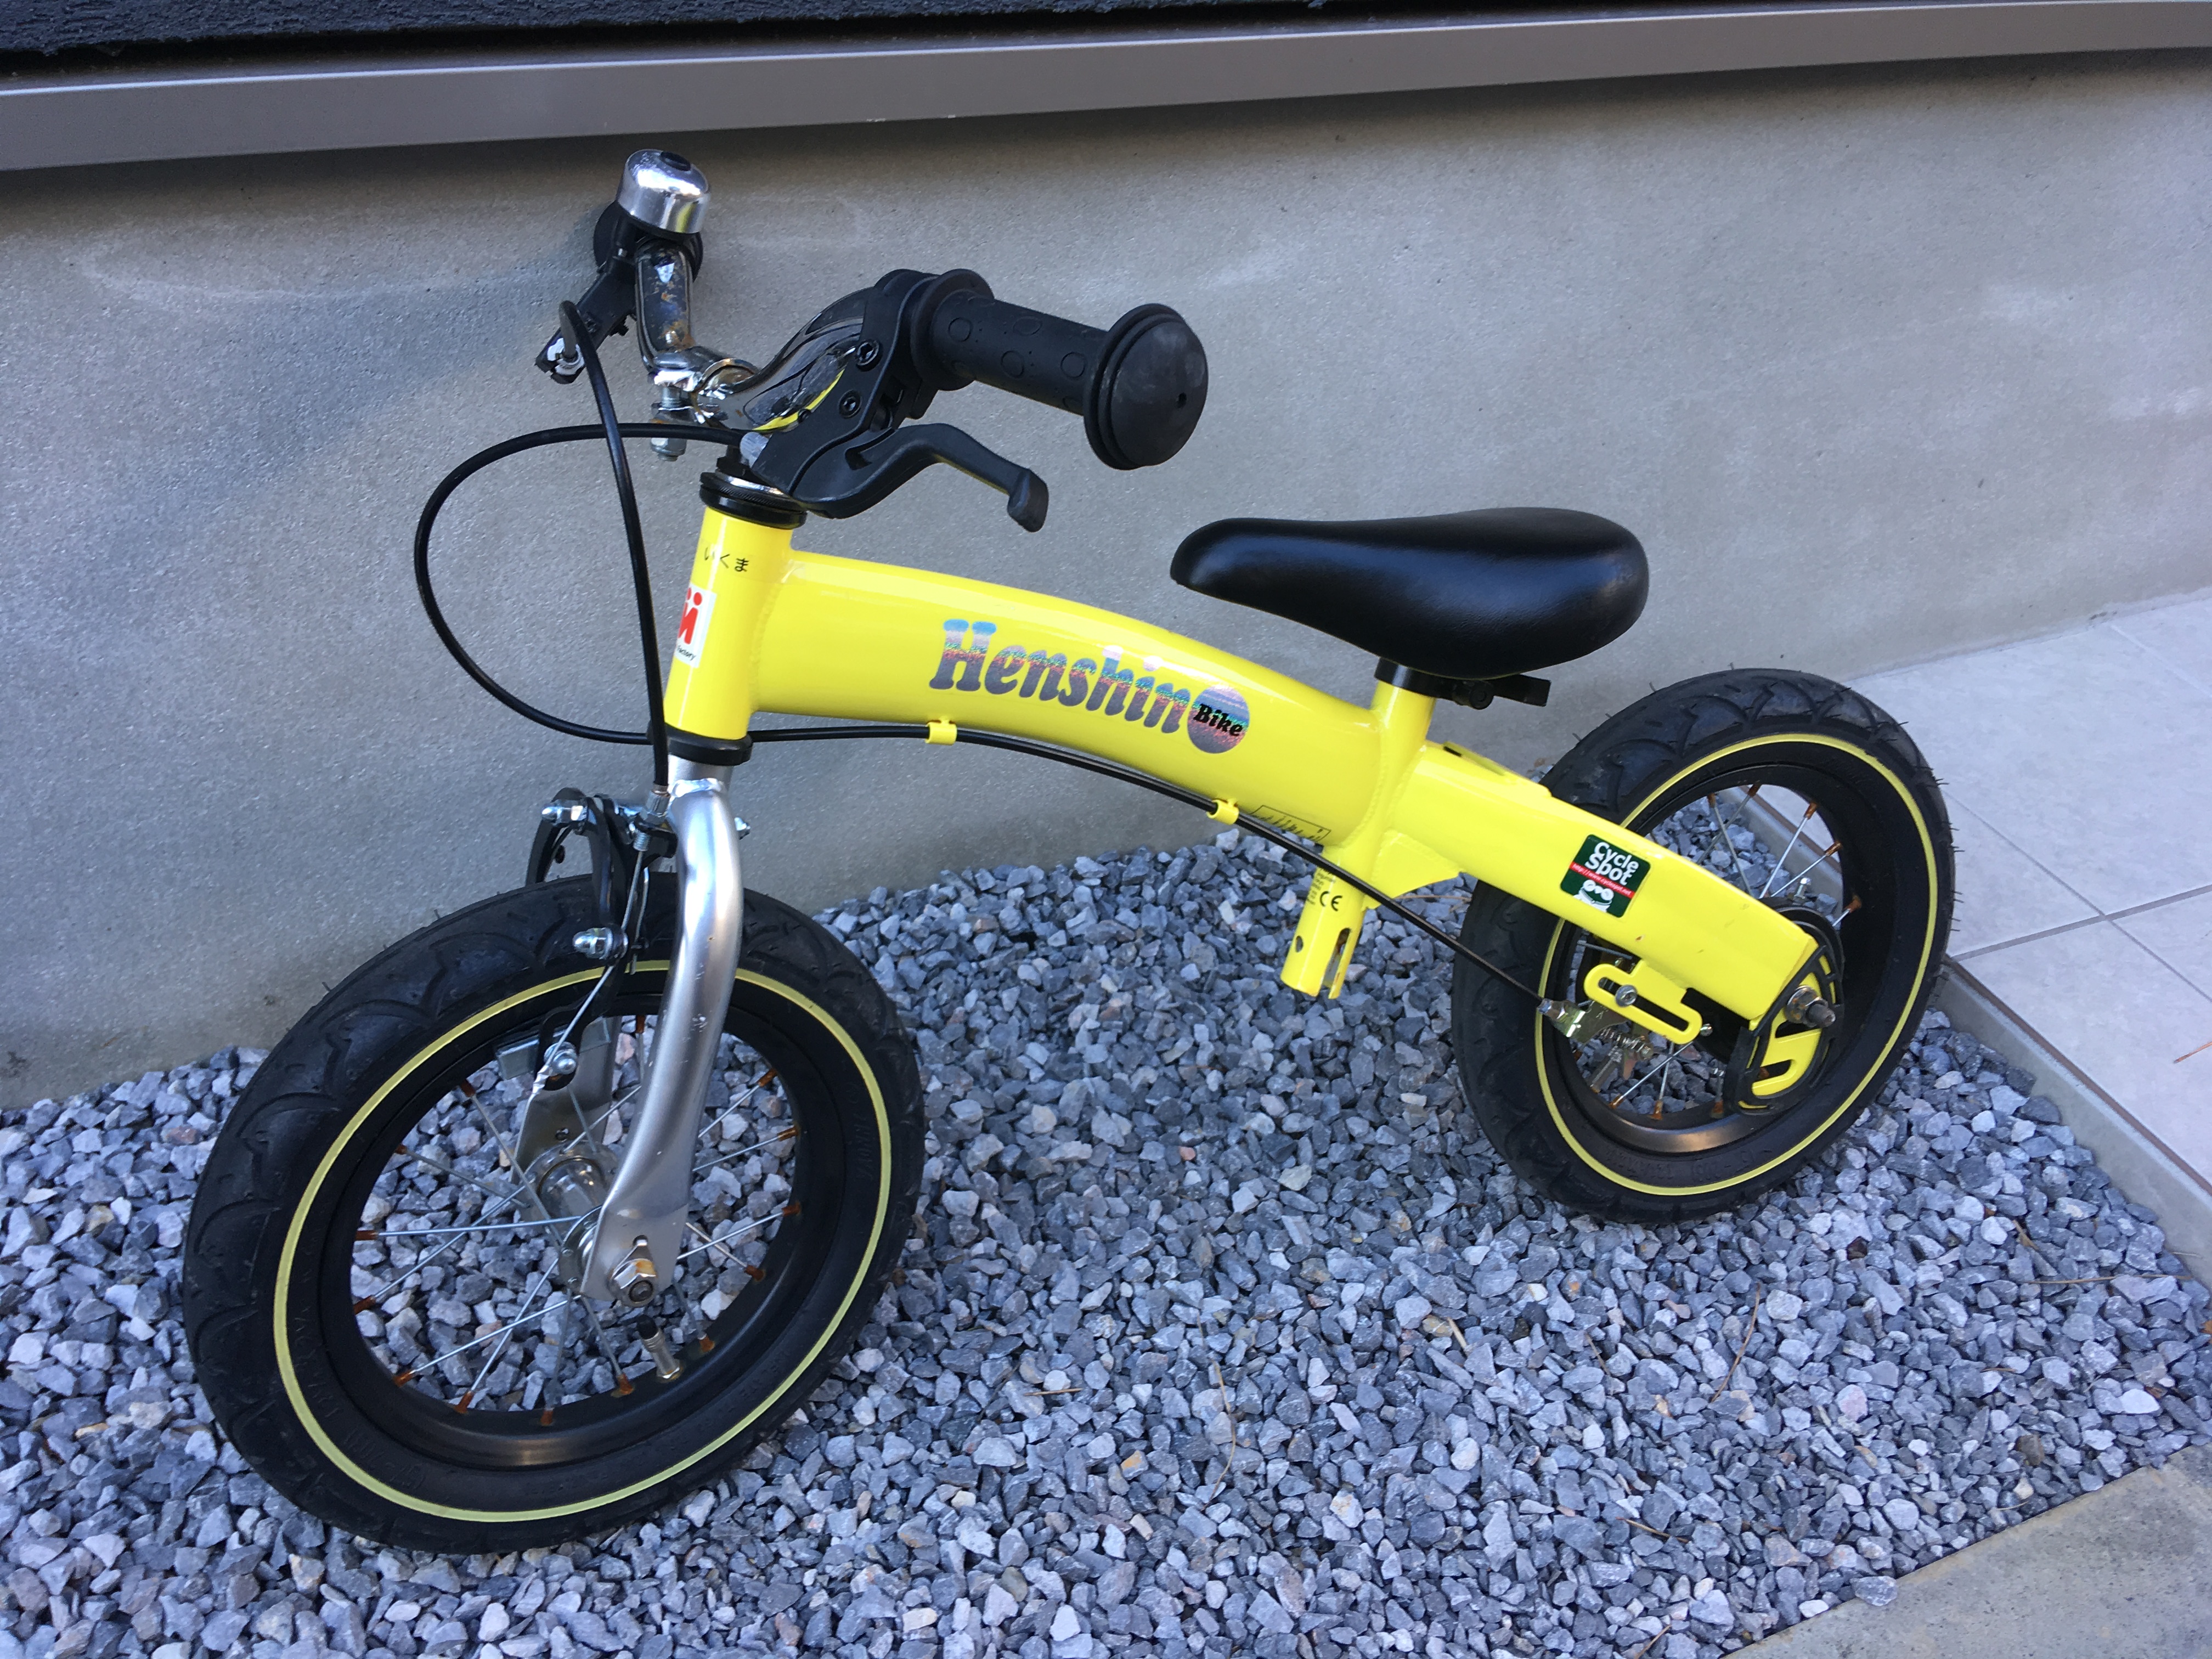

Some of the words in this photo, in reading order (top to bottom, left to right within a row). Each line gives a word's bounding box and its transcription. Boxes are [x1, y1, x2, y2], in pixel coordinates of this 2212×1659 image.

[929, 618, 1192, 734] Henshin
[1193, 703, 1243, 737] Bike
[1584, 853, 1636, 886] Spot
[1594, 842, 1639, 871] Cycle
[1319, 890, 1343, 912] CE
